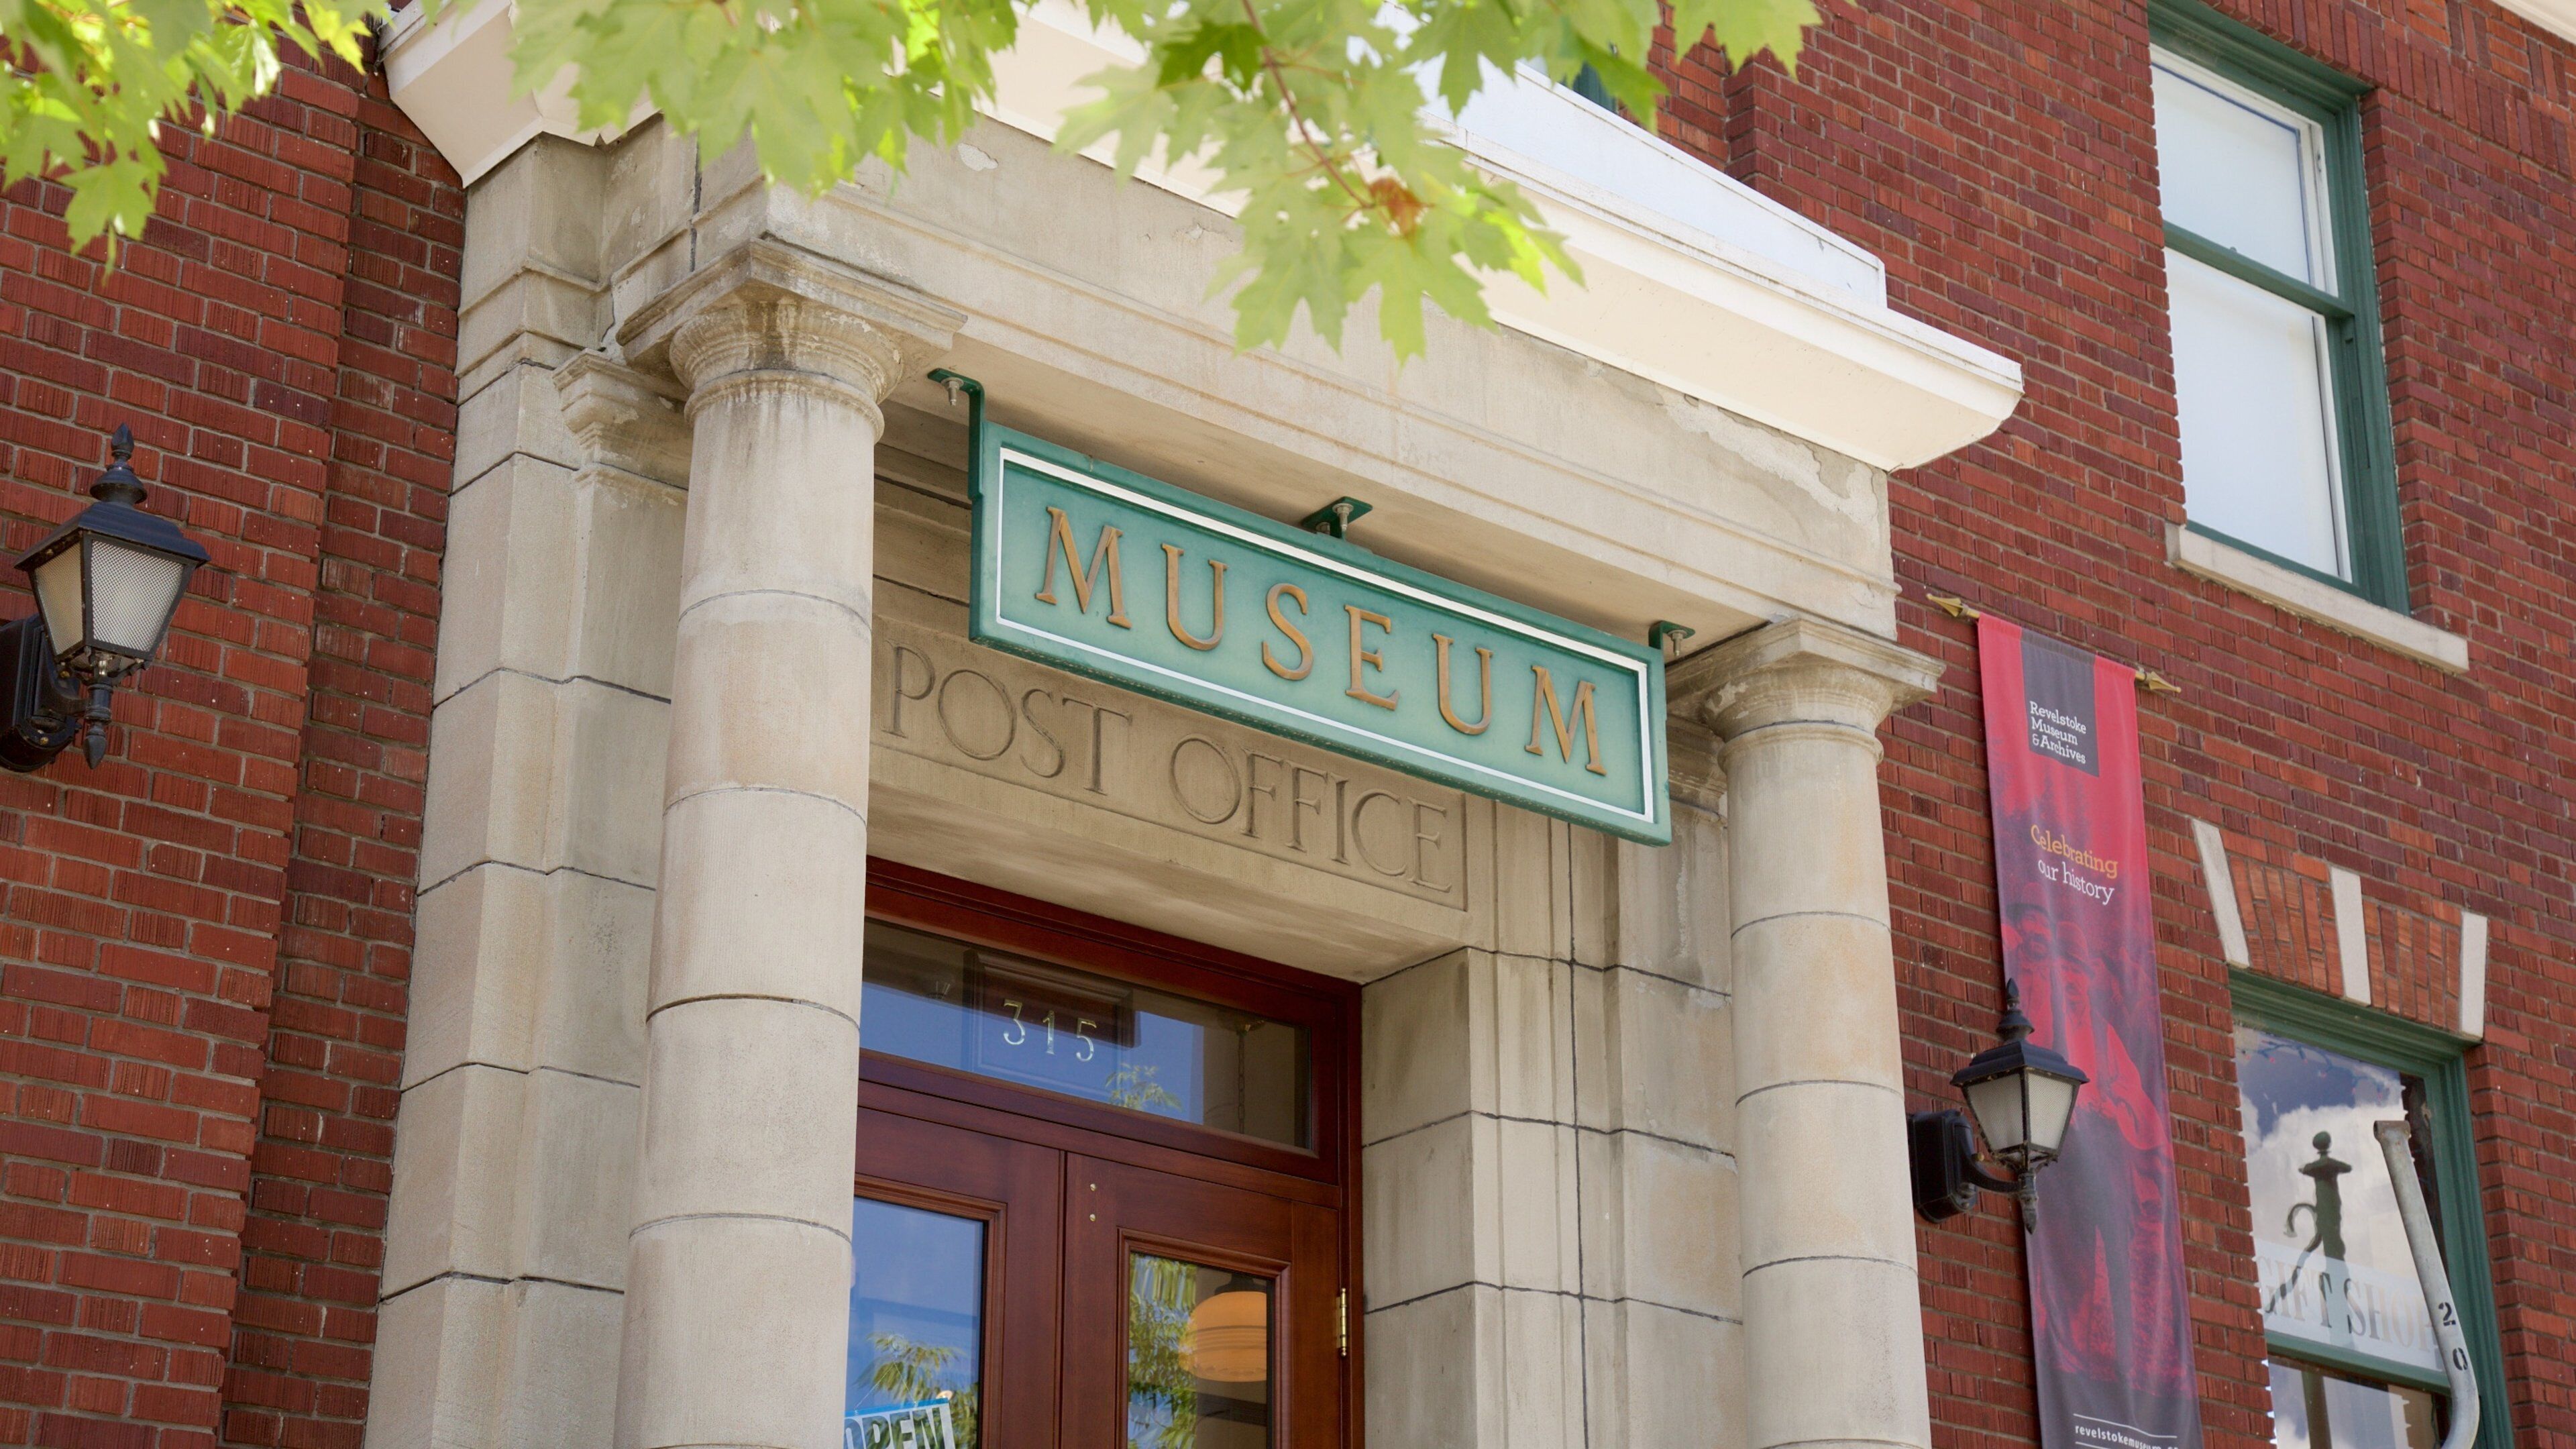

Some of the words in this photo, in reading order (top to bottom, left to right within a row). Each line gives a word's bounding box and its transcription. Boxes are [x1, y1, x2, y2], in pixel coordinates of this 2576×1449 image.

[1034, 506, 1607, 777] MUSEUM
[2029, 700, 2087, 735] Revelstoke
[2031, 716, 2078, 746] Museum
[881, 638, 1133, 796] POST
[1169, 733, 1452, 894] OFFICE
[2030, 824, 2118, 879] Celebrating
[2037, 859, 2059, 881] our
[2061, 861, 2115, 906] history
[1003, 998, 1097, 1062] 315
